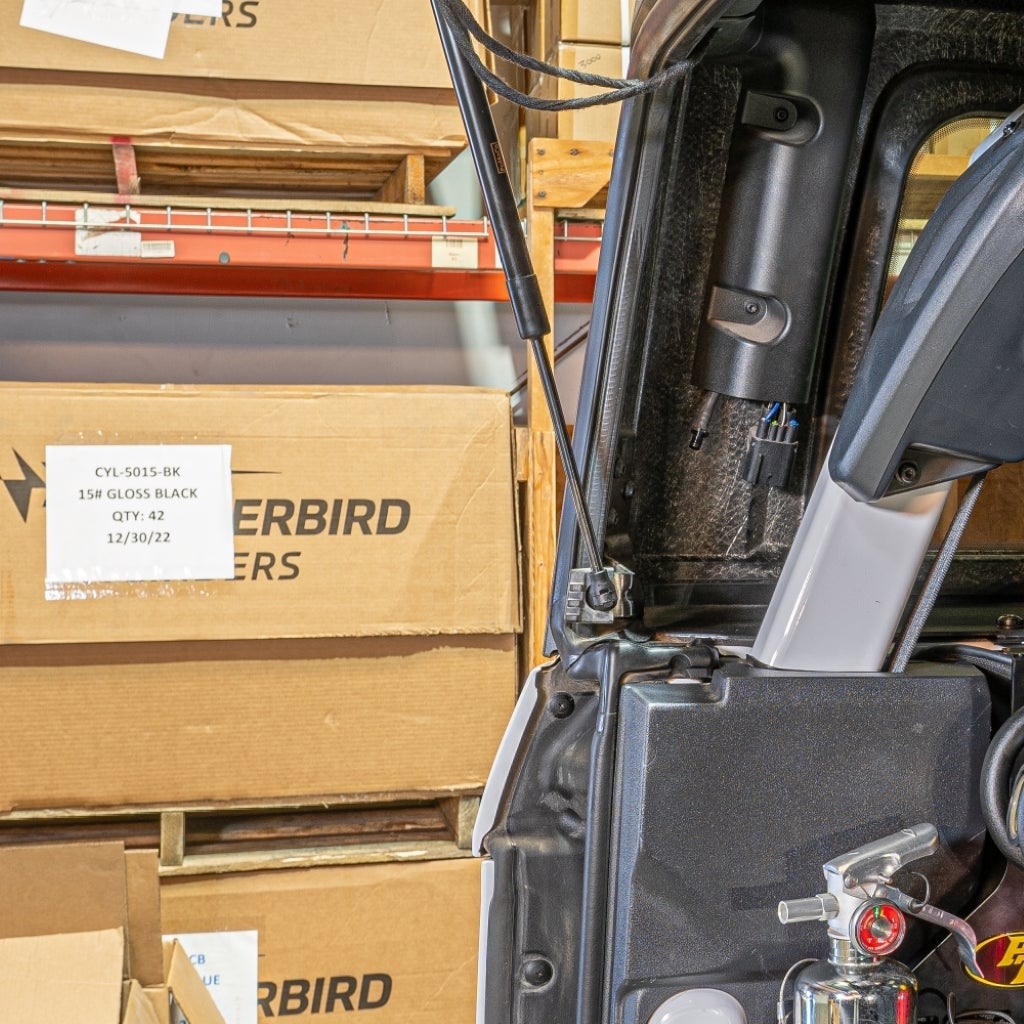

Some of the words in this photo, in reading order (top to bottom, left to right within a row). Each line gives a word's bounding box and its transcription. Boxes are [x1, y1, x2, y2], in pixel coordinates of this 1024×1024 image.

[95, 467, 181, 478] CYL-5015-BK
[79, 489, 102, 500] 15#
[107, 489, 151, 500] GLOSS
[155, 488, 198, 499] BLACK
[112, 511, 145, 522] QTY:
[148, 510, 165, 521] 42
[107, 531, 171, 545] 12/30/22
